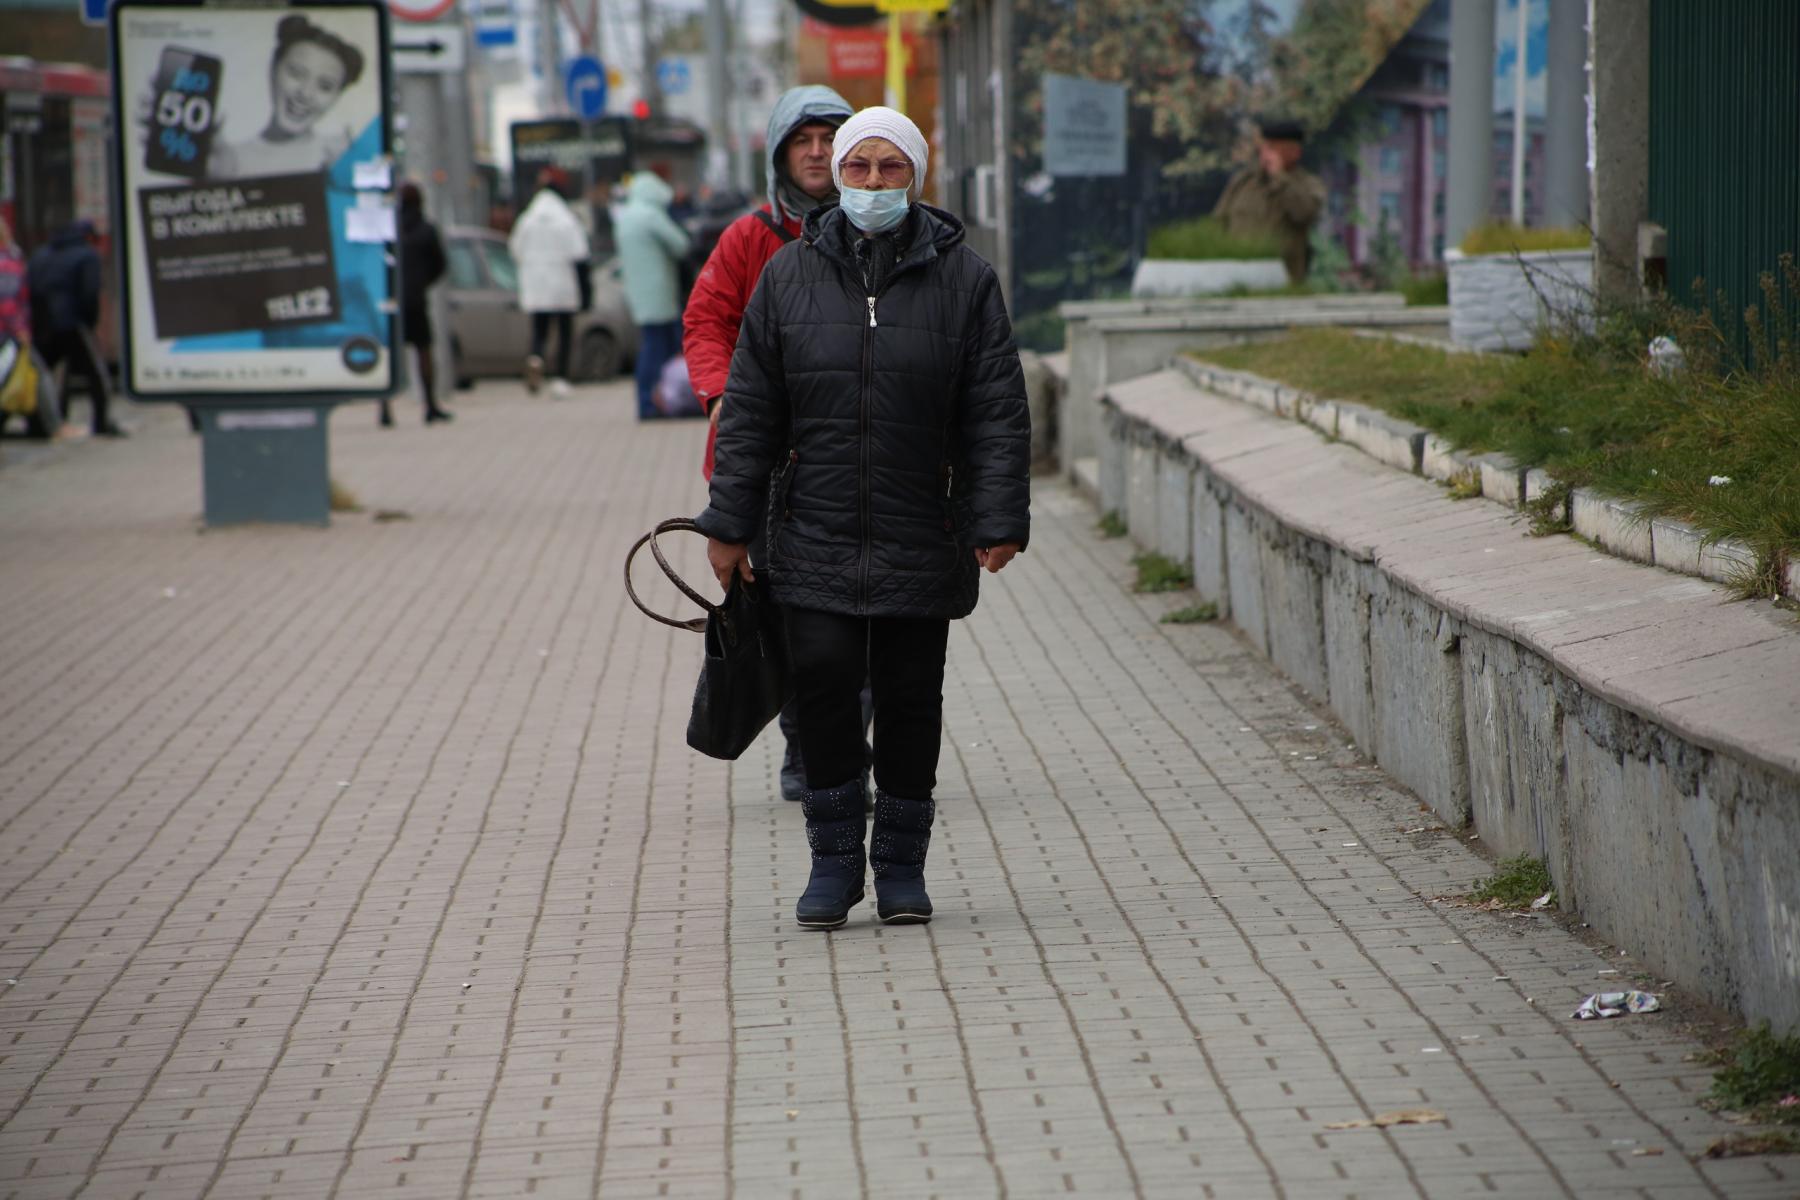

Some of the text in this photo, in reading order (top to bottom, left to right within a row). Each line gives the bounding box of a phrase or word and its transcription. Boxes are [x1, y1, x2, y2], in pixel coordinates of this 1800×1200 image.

[157, 90, 212, 133] 50
[160, 127, 198, 162] %
[150, 187, 247, 216] ВЫГОДА
[171, 203, 305, 236] КОМПЛЕКТЕ
[265, 287, 332, 321] TELE2
